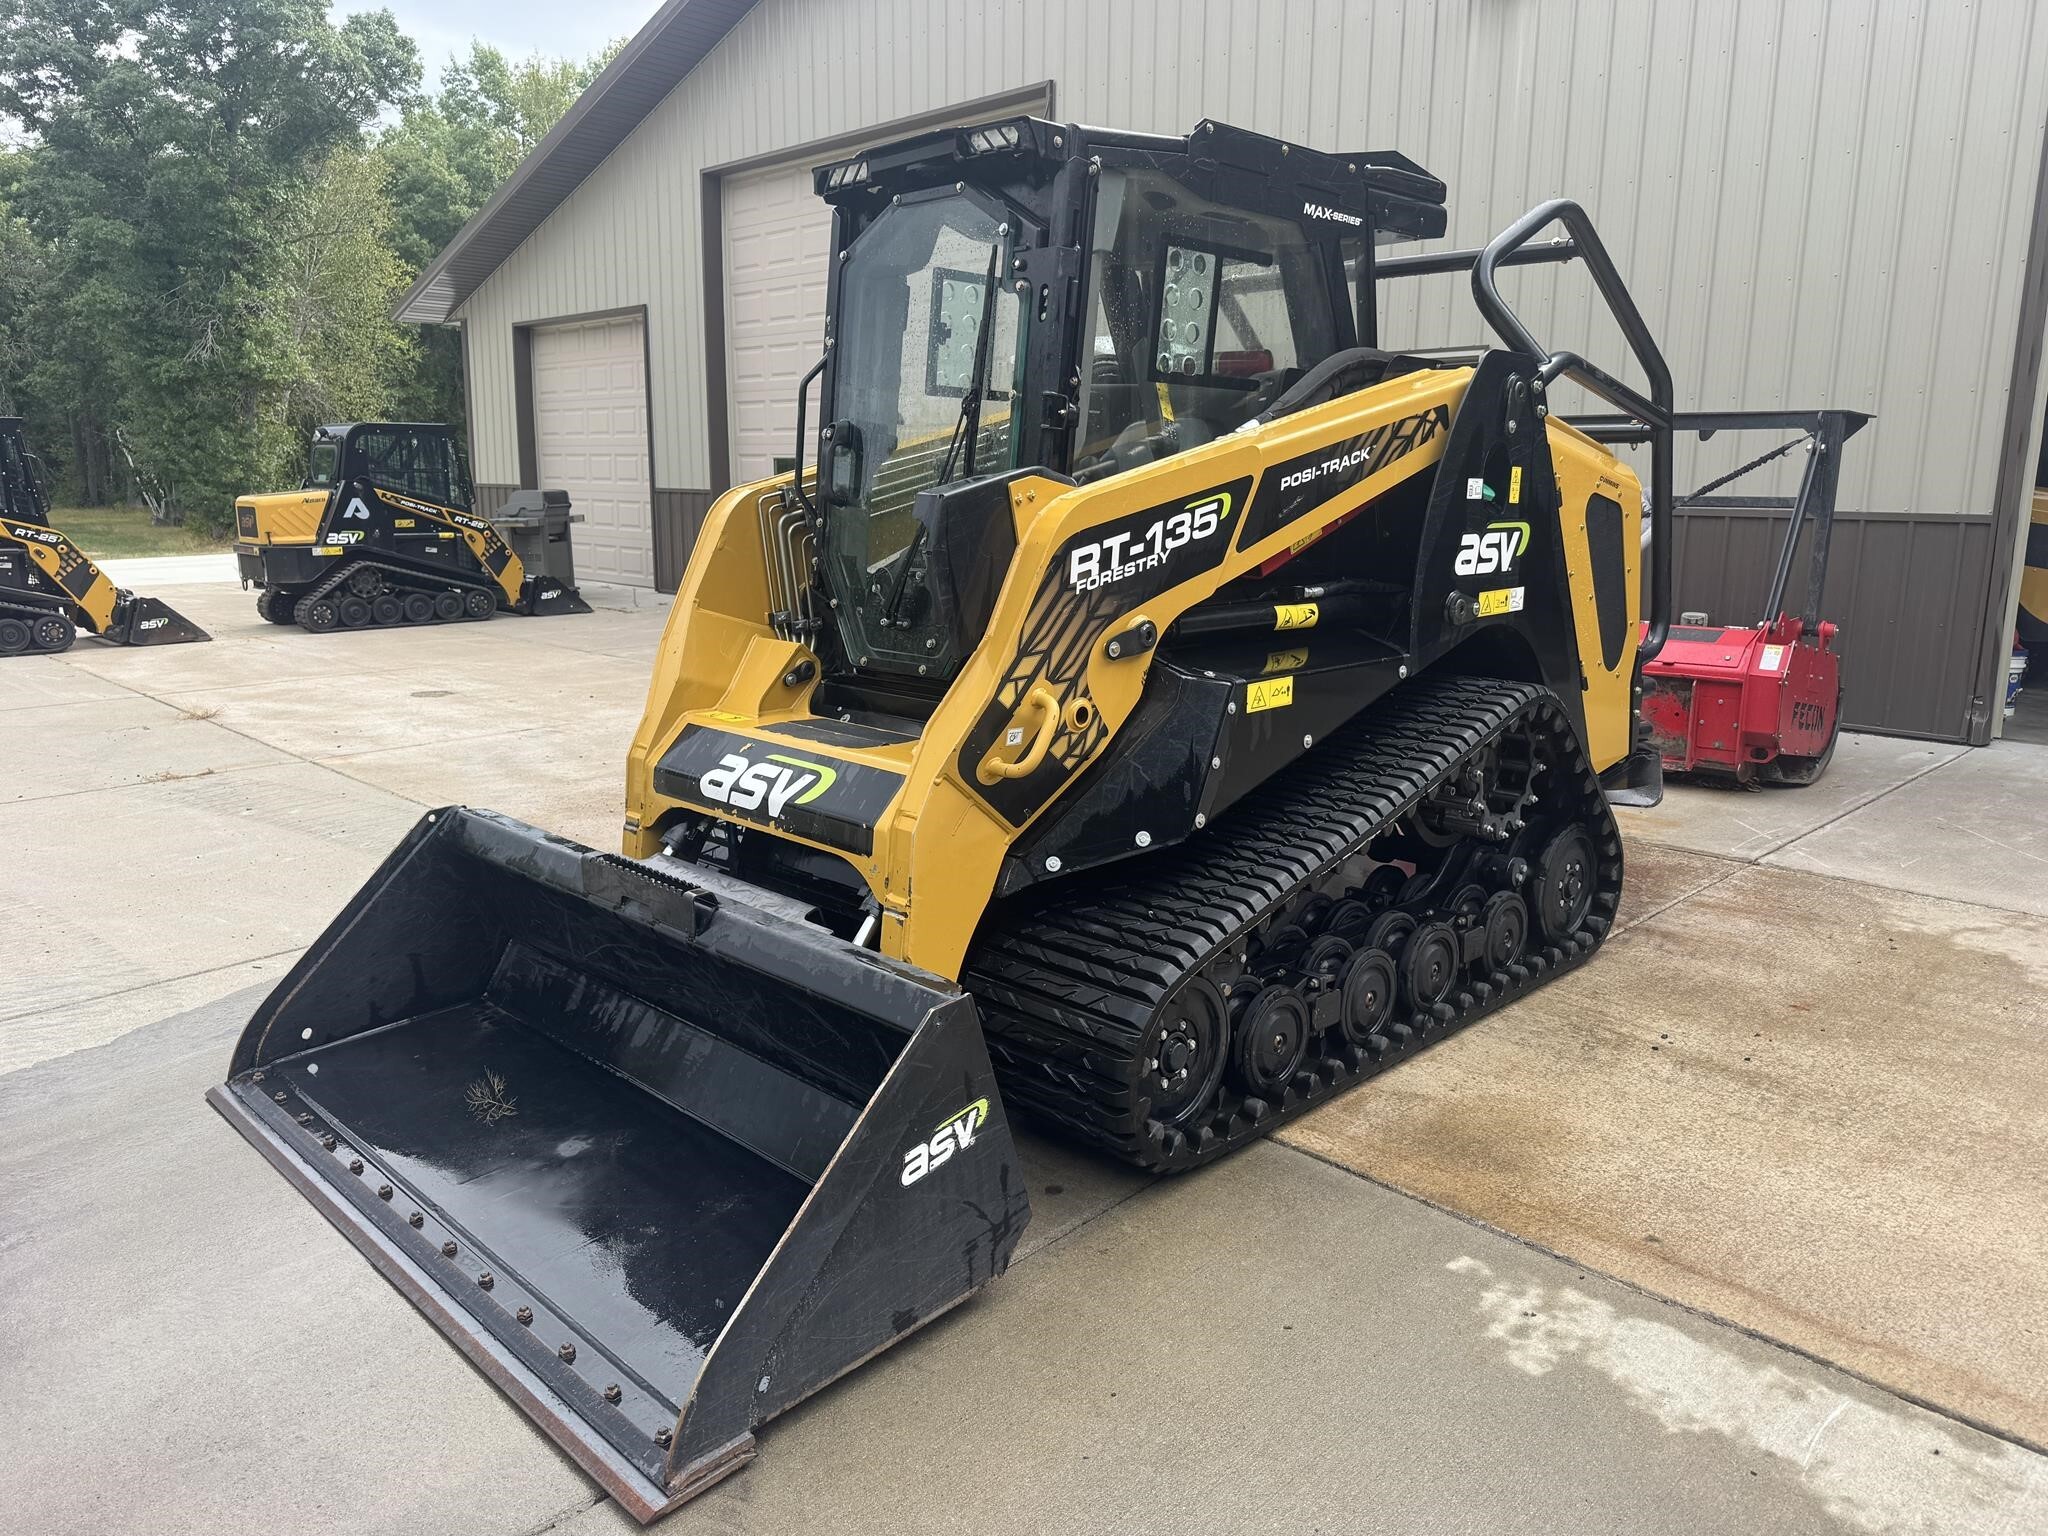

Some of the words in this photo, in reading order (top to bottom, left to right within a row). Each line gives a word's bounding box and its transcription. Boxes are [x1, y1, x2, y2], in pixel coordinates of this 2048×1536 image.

[1303, 202, 1363, 226] MAX-SERIES
[1280, 446, 1371, 491] POSI-TRACK
[1069, 502, 1219, 585] RT-135
[1075, 550, 1171, 595] FORESTRY
